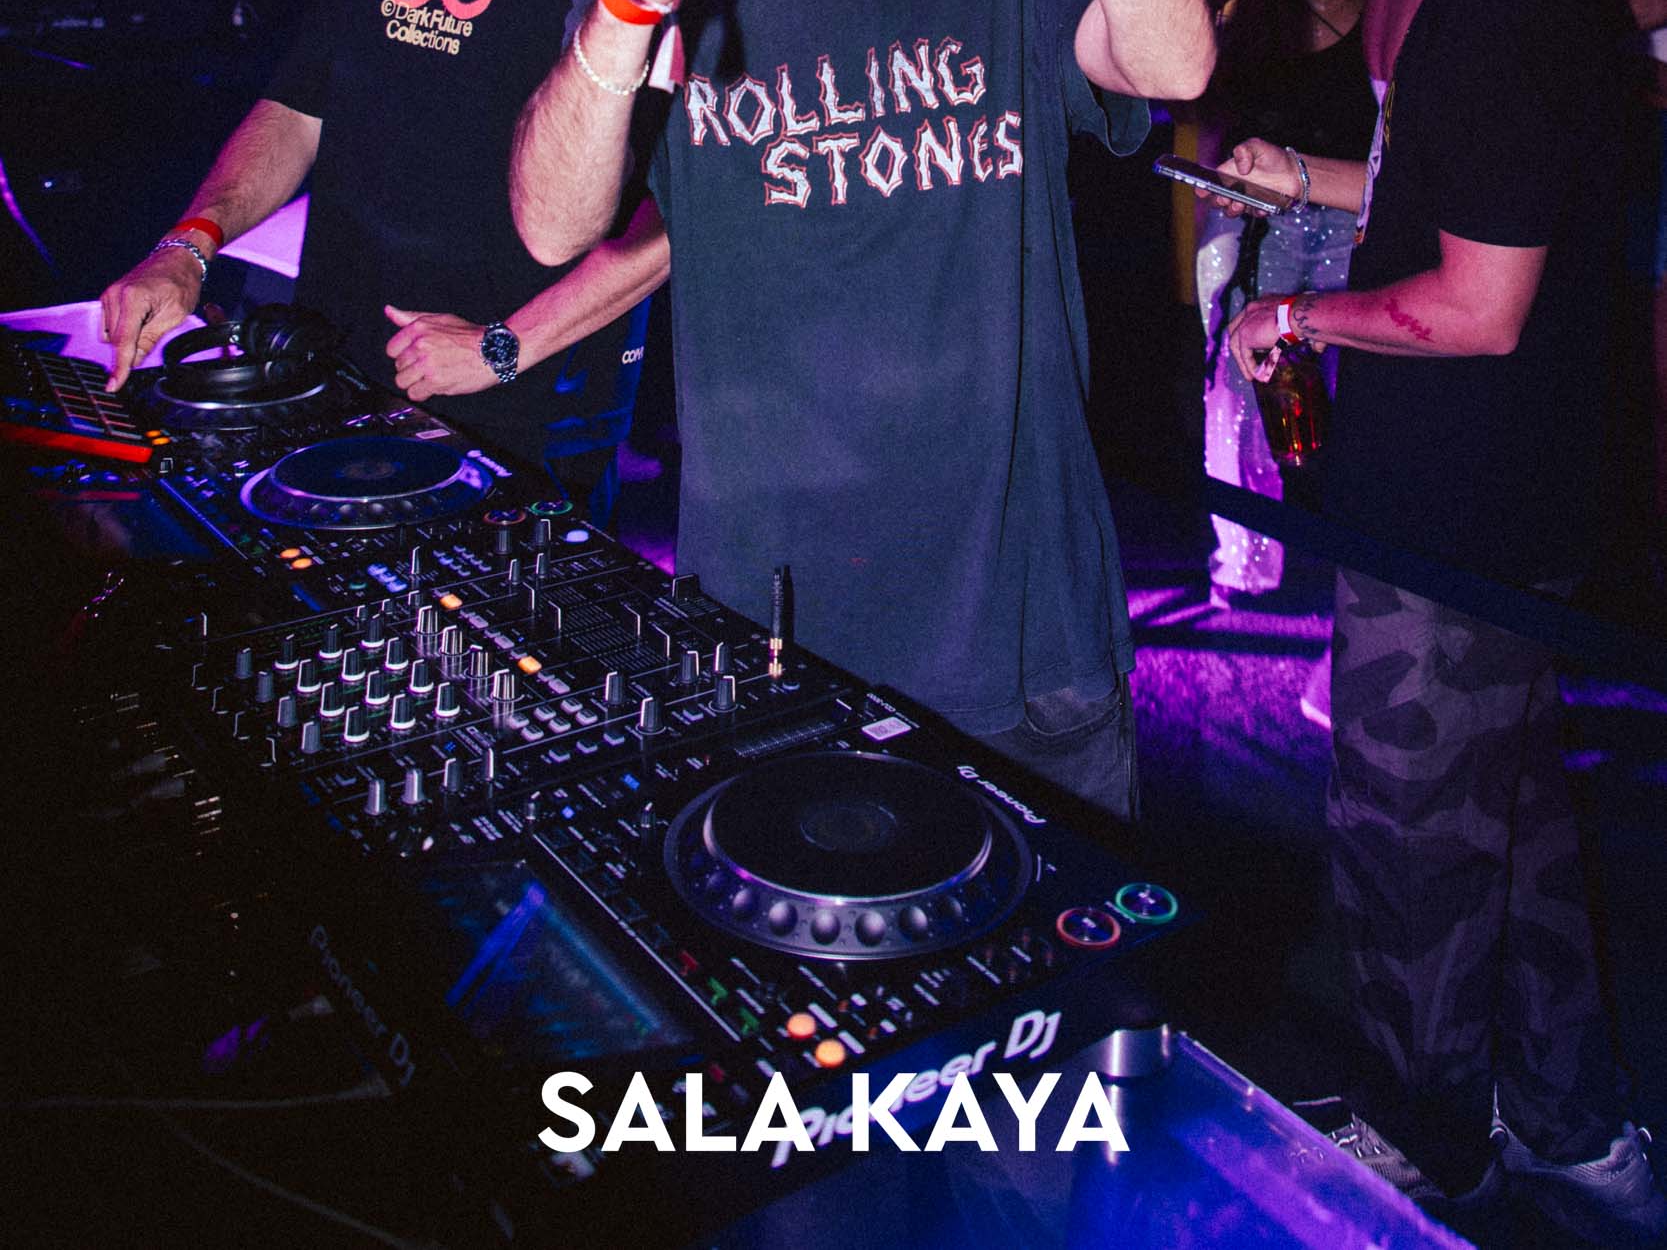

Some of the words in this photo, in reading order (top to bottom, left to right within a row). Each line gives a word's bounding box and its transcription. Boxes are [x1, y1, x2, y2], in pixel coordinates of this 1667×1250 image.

[386, 19, 461, 55] Collections
[684, 36, 987, 147] ROLLING
[760, 110, 1023, 209] STONES
[976, 778, 1048, 826] Pioneer
[1001, 1008, 1063, 1061] DJ
